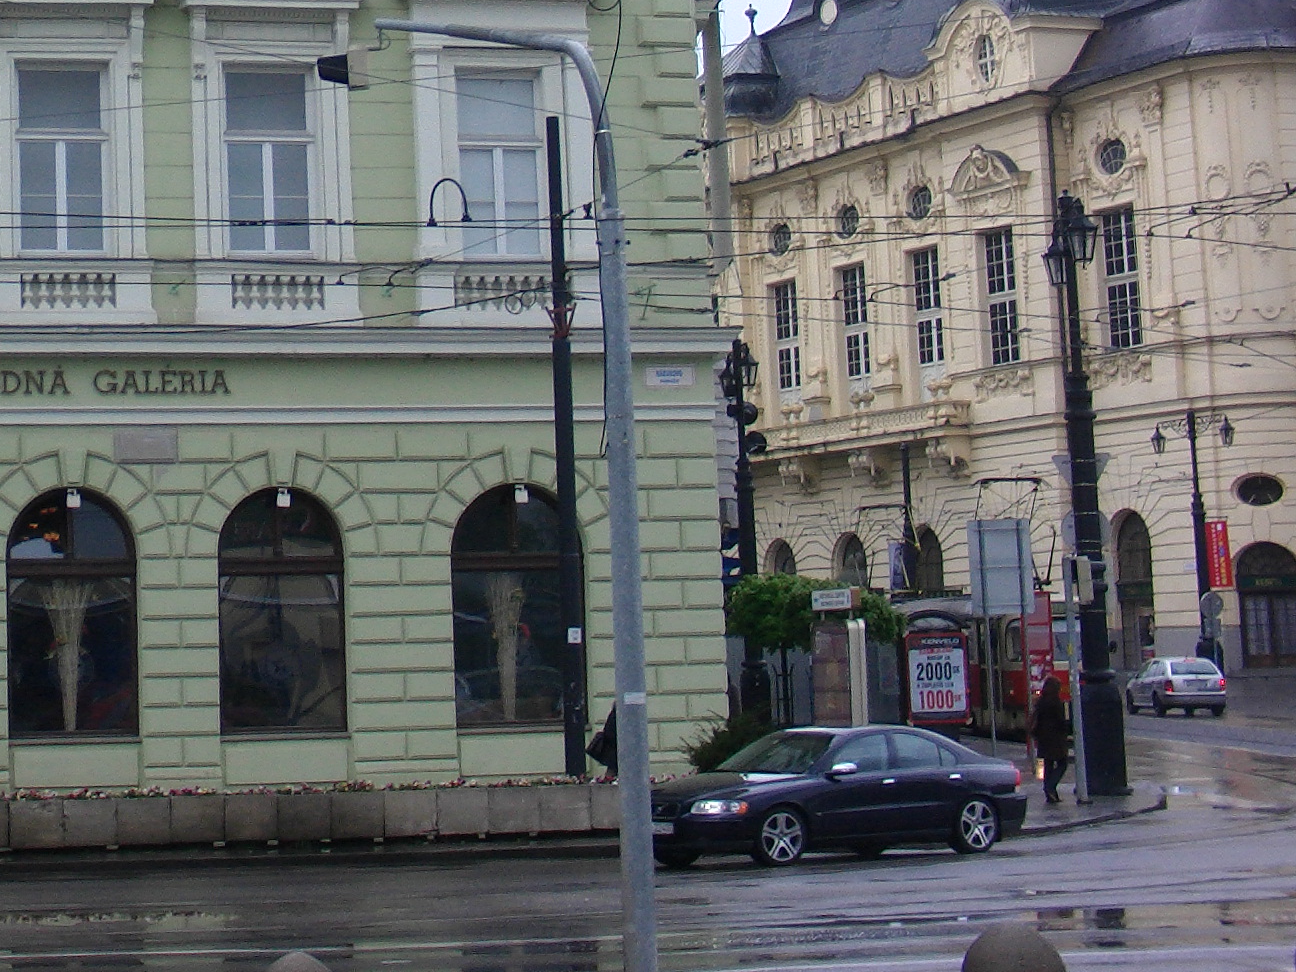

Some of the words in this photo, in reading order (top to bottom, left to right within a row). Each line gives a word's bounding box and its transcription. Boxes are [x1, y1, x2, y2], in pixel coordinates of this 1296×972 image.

[92, 363, 231, 395] GALÉRIA
[916, 661, 952, 681] 2000
[918, 689, 954, 710] 1000
